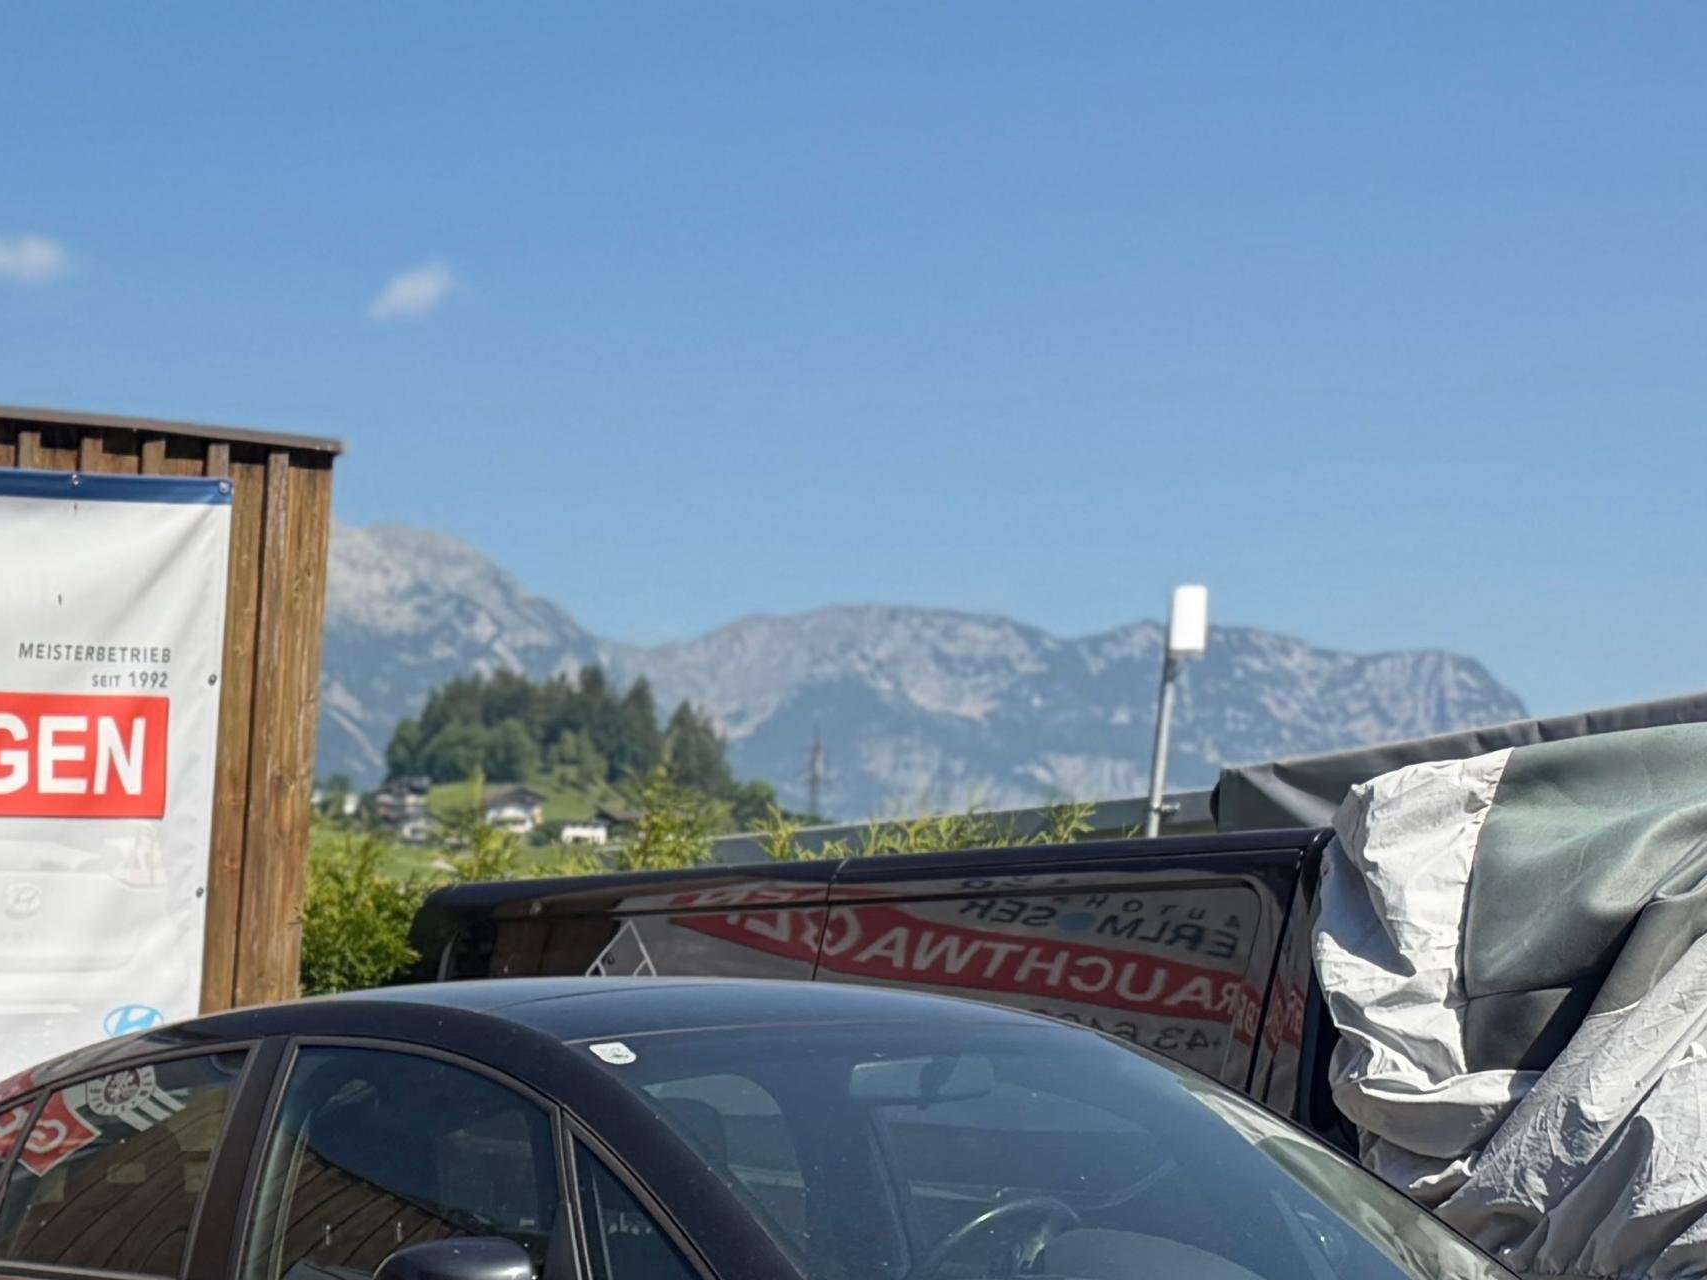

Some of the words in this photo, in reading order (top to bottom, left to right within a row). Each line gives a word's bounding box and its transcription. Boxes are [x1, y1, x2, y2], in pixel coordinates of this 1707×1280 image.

[18, 642, 172, 664] MEISTERBETRIEB
[91, 674, 121, 688] SEIT
[128, 671, 169, 689] 1992
